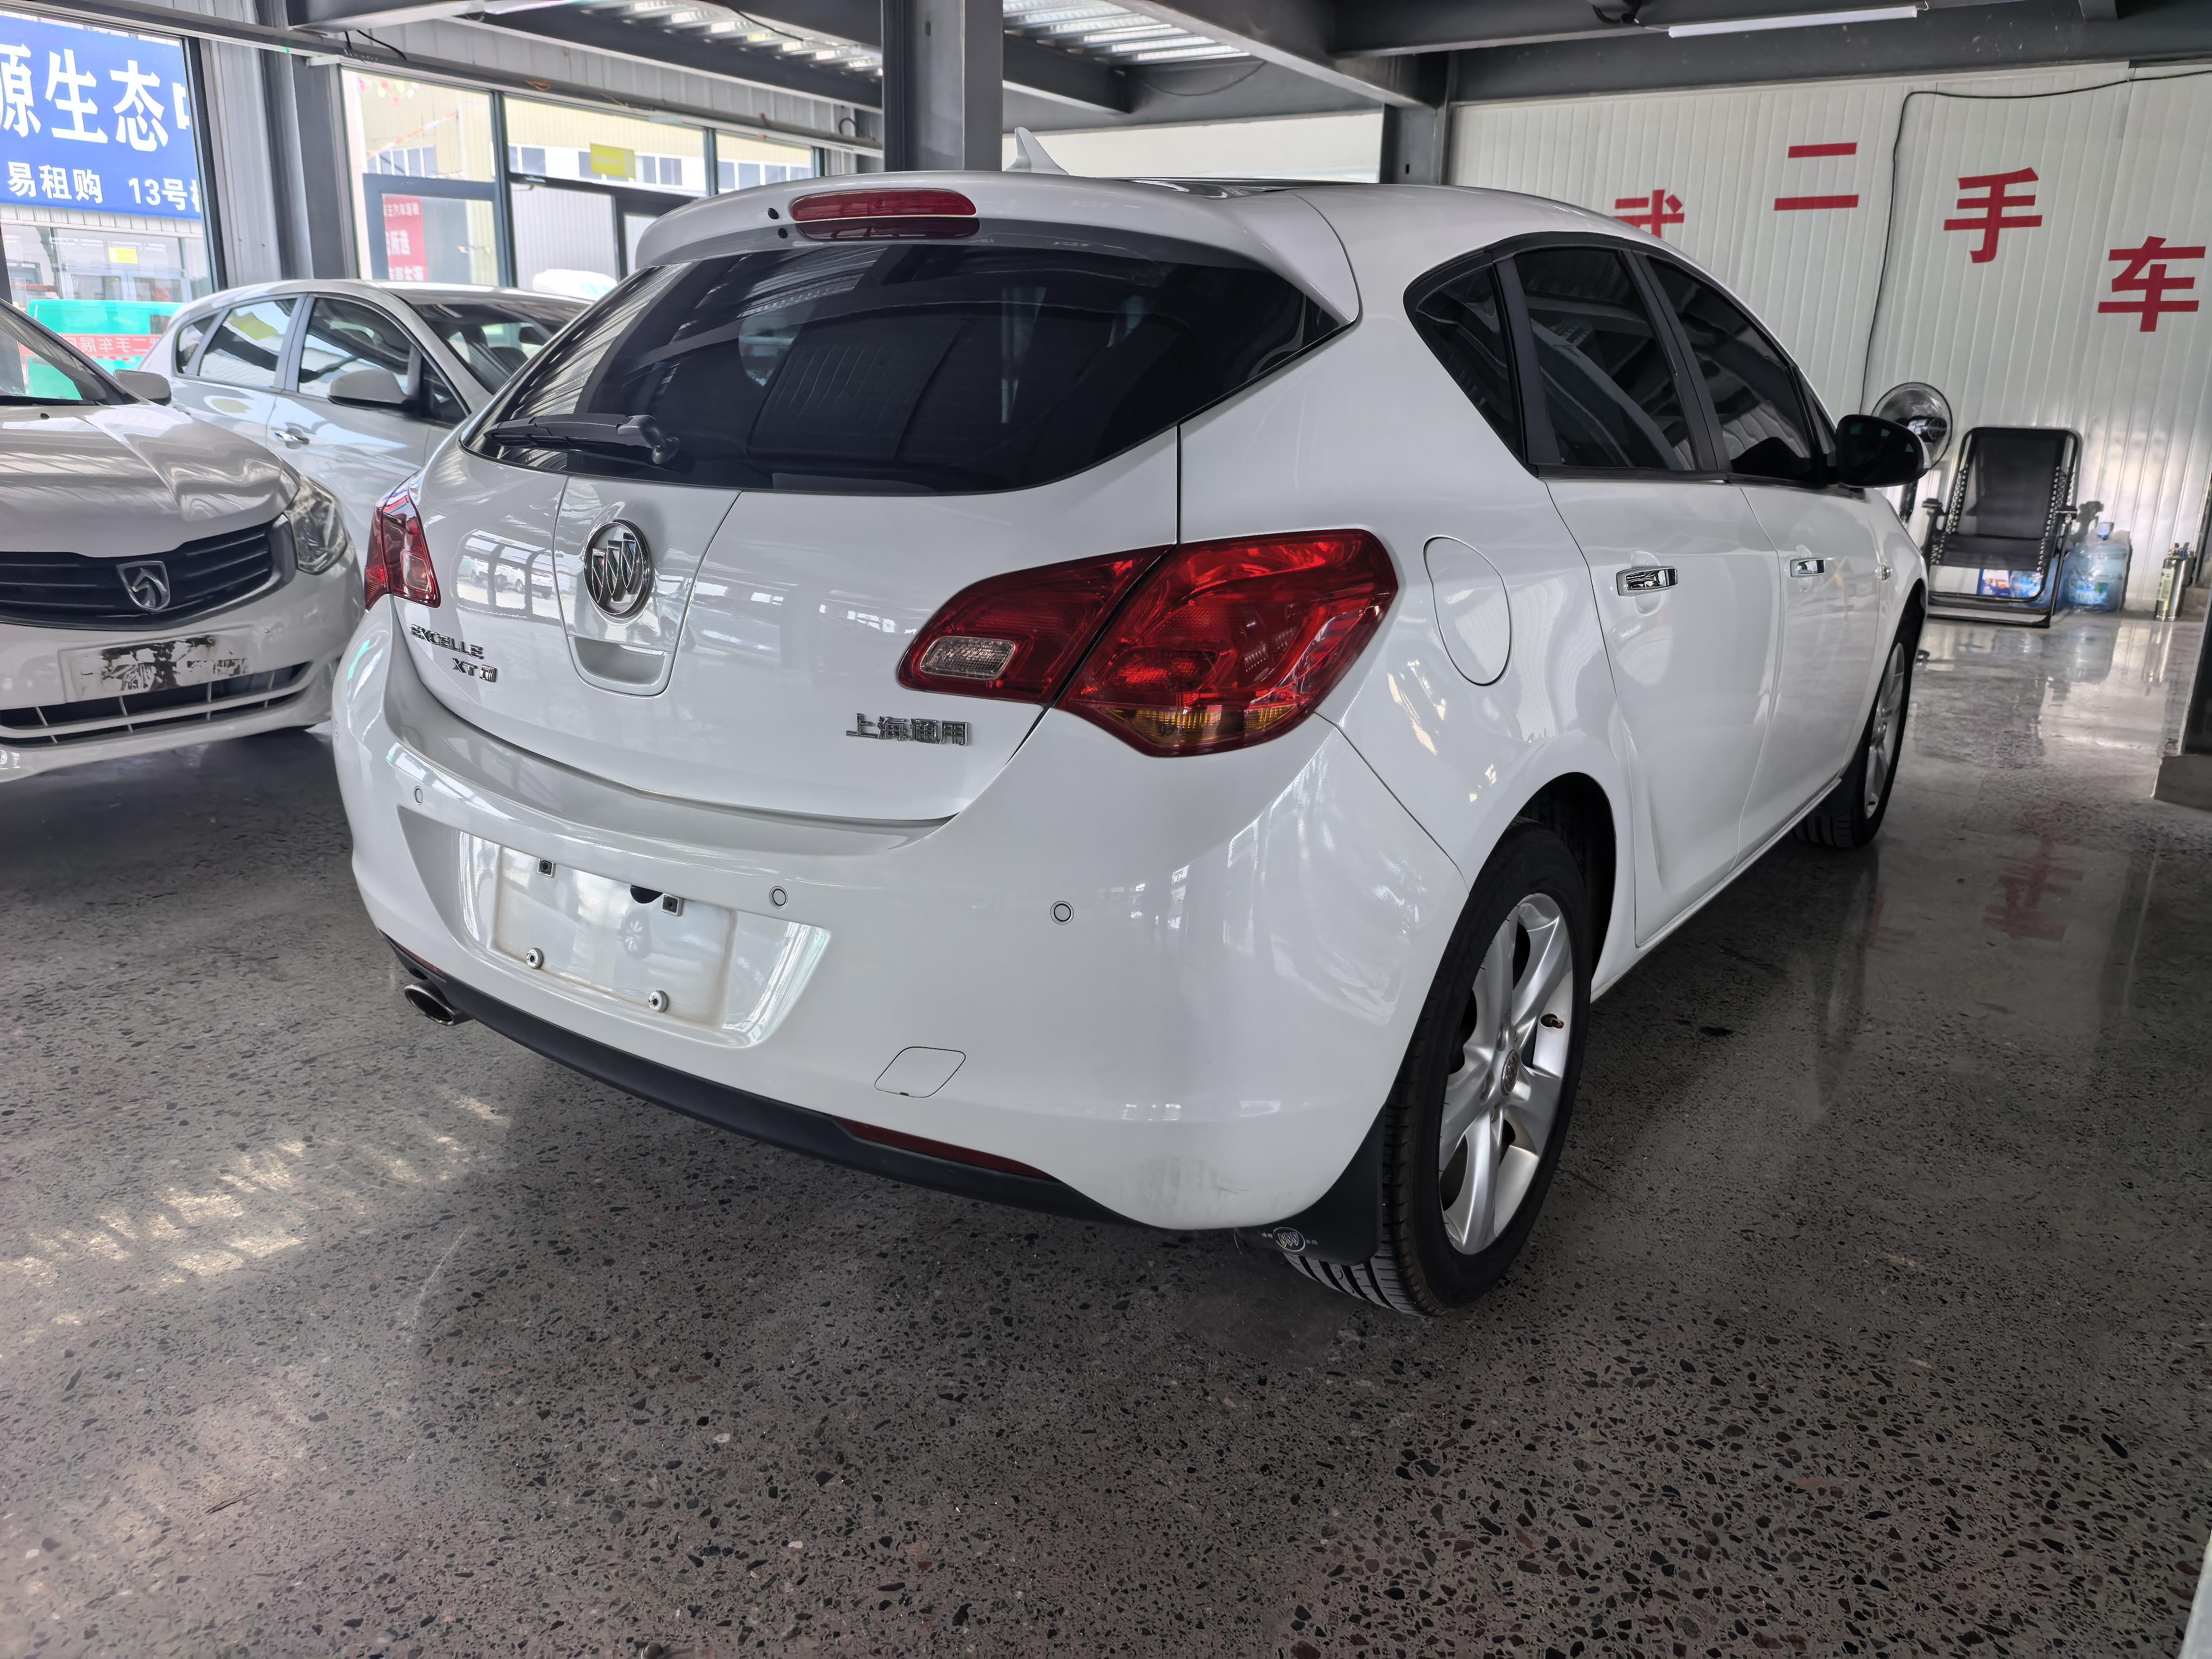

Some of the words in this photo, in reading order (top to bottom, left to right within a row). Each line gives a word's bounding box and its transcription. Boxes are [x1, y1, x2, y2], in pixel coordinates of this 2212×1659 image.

[8, 161, 103, 204] 易租购
[410, 624, 484, 659] EXCELLE
[846, 713, 968, 746] 上海通用
